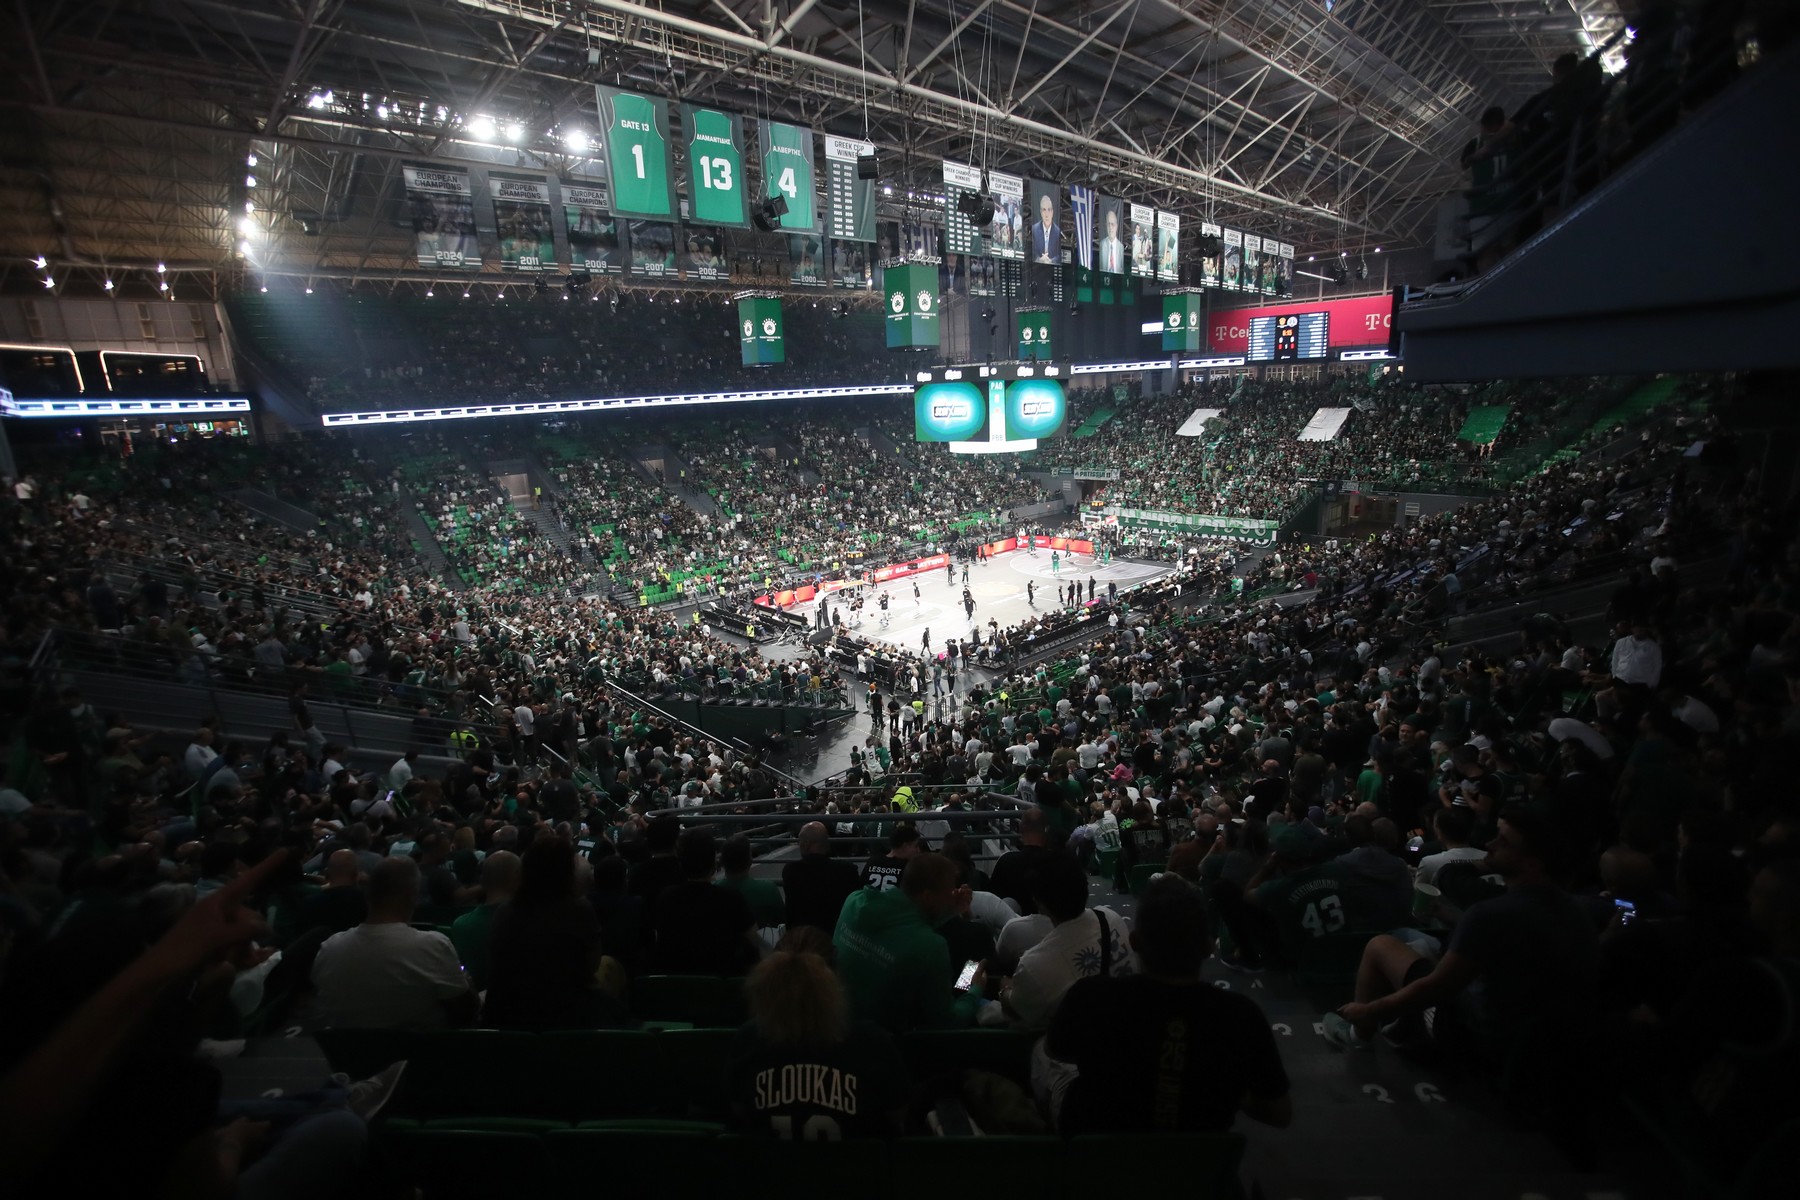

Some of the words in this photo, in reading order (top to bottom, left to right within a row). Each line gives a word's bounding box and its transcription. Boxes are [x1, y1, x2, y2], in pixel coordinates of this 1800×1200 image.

[621, 120, 640, 130] GATE
[641, 122, 650, 132] 13
[834, 140, 852, 150] GREEK
[631, 144, 646, 179] 1
[416, 171, 458, 184] EUROPEAN
[700, 156, 733, 190] 13
[414, 179, 462, 191] CHAMPIONS
[500, 182, 538, 192] EUROPEAN
[778, 168, 798, 198] 4
[499, 189, 542, 200] CHAMPIONS
[570, 190, 604, 200] EUROPEAN
[569, 196, 608, 206] CHAMPIONS
[436, 250, 464, 261] 2024
[520, 256, 539, 266] 2011
[584, 260, 607, 269] 2009
[644, 262, 664, 272] 2007
[698, 268, 718, 276] 2002
[868, 865, 902, 876] LESSORT
[868, 873, 898, 892] 26
[1301, 894, 1345, 938] 43
[754, 1064, 857, 1116] SLOUKAS
